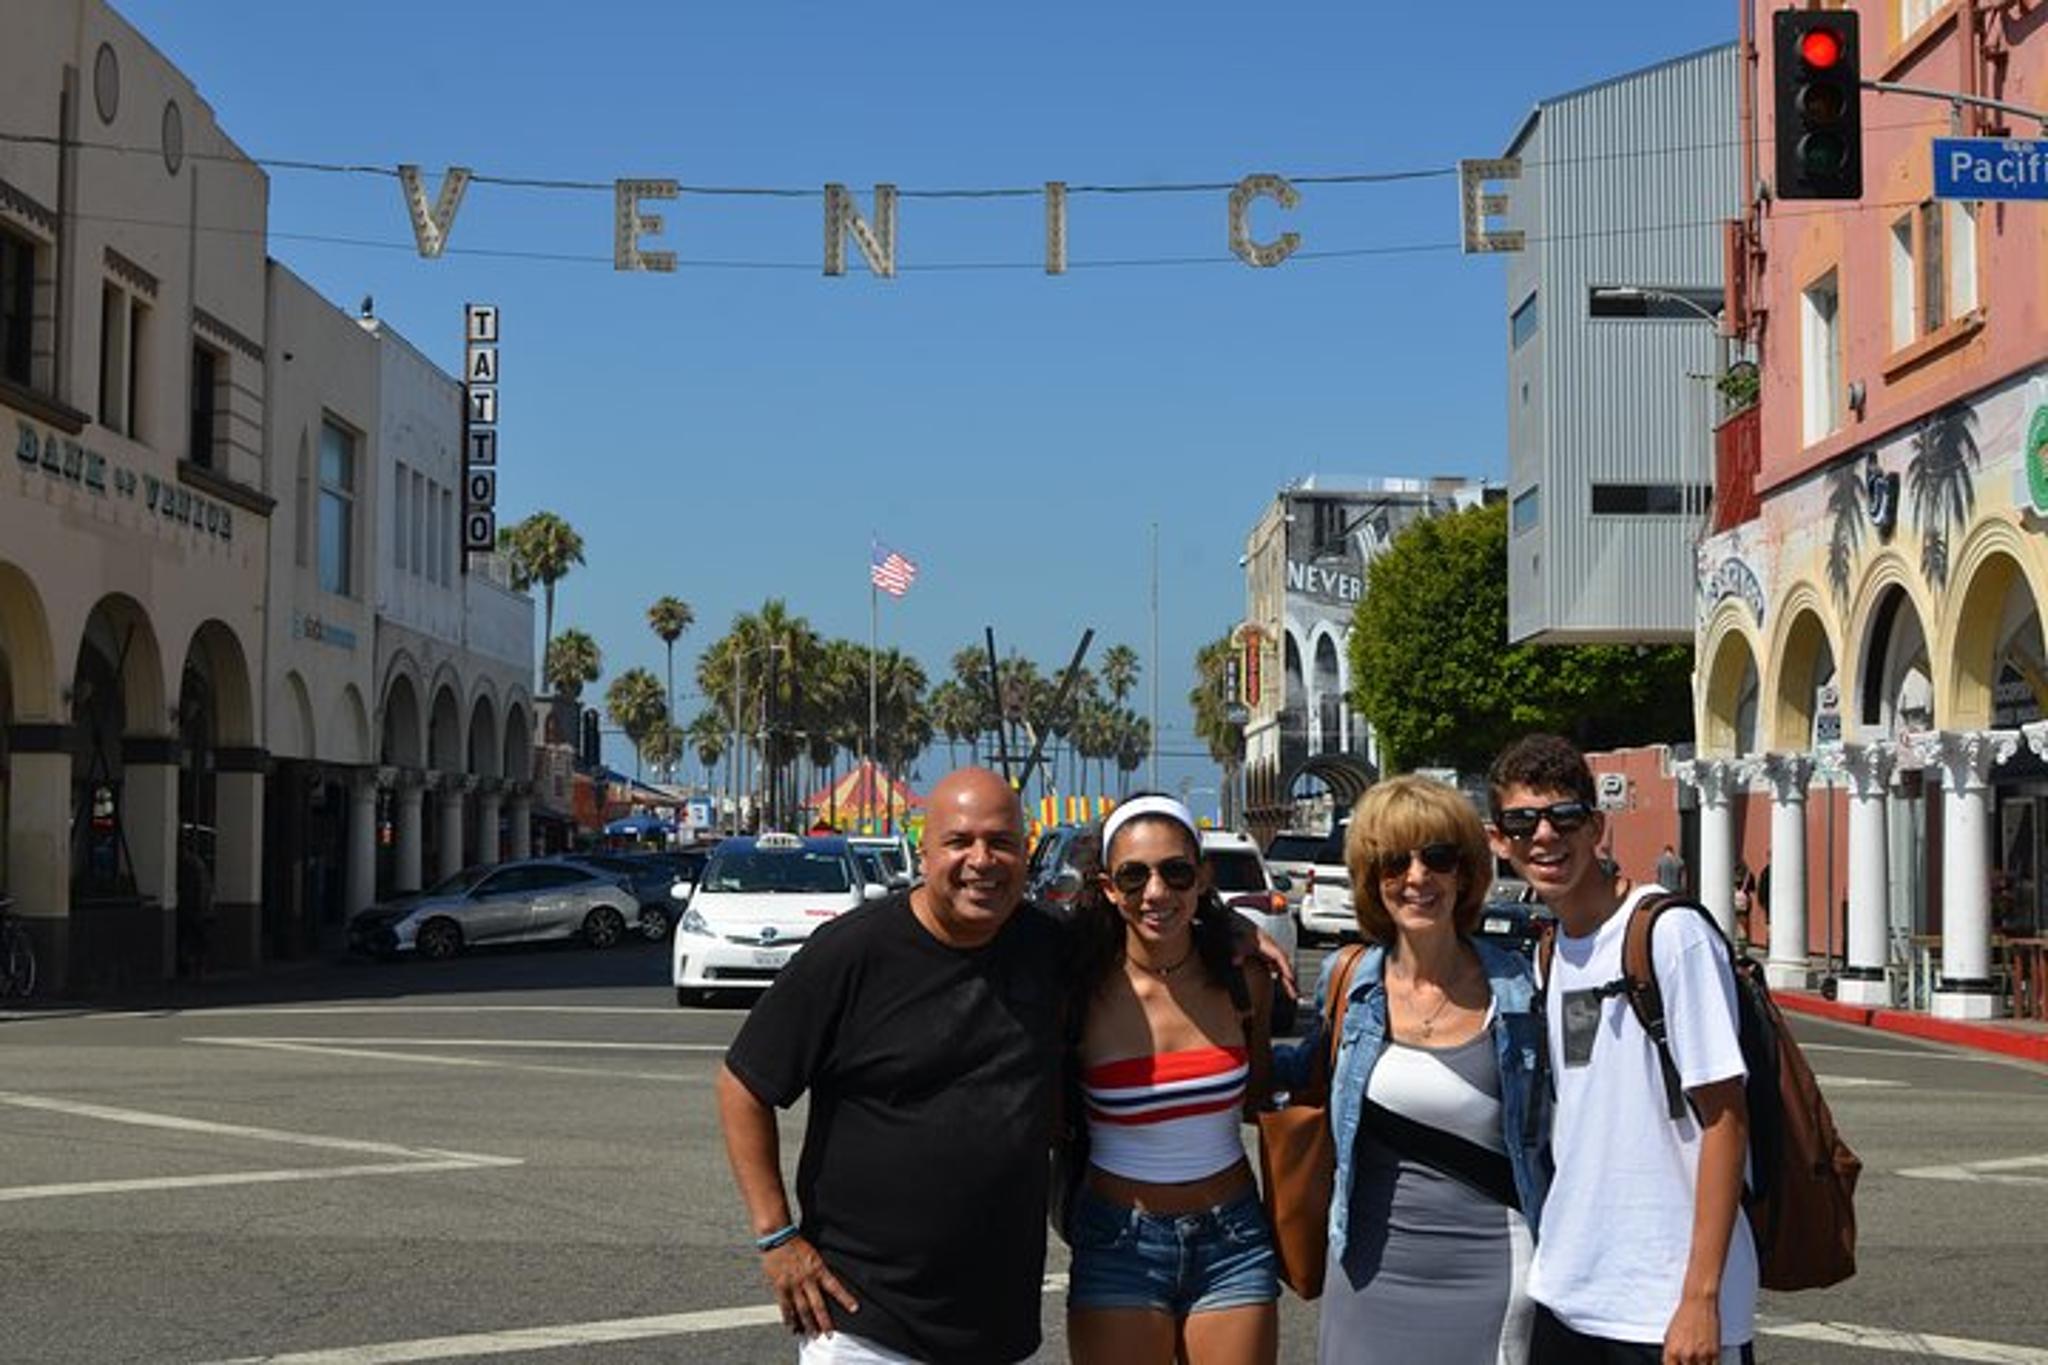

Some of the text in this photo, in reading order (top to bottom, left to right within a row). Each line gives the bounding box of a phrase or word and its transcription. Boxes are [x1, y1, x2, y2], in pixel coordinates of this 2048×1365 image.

[396, 158, 1526, 278] VENICE
[16, 418, 107, 493] BANK
[471, 310, 491, 543] TATTOO
[1288, 560, 1361, 601] NEVER
